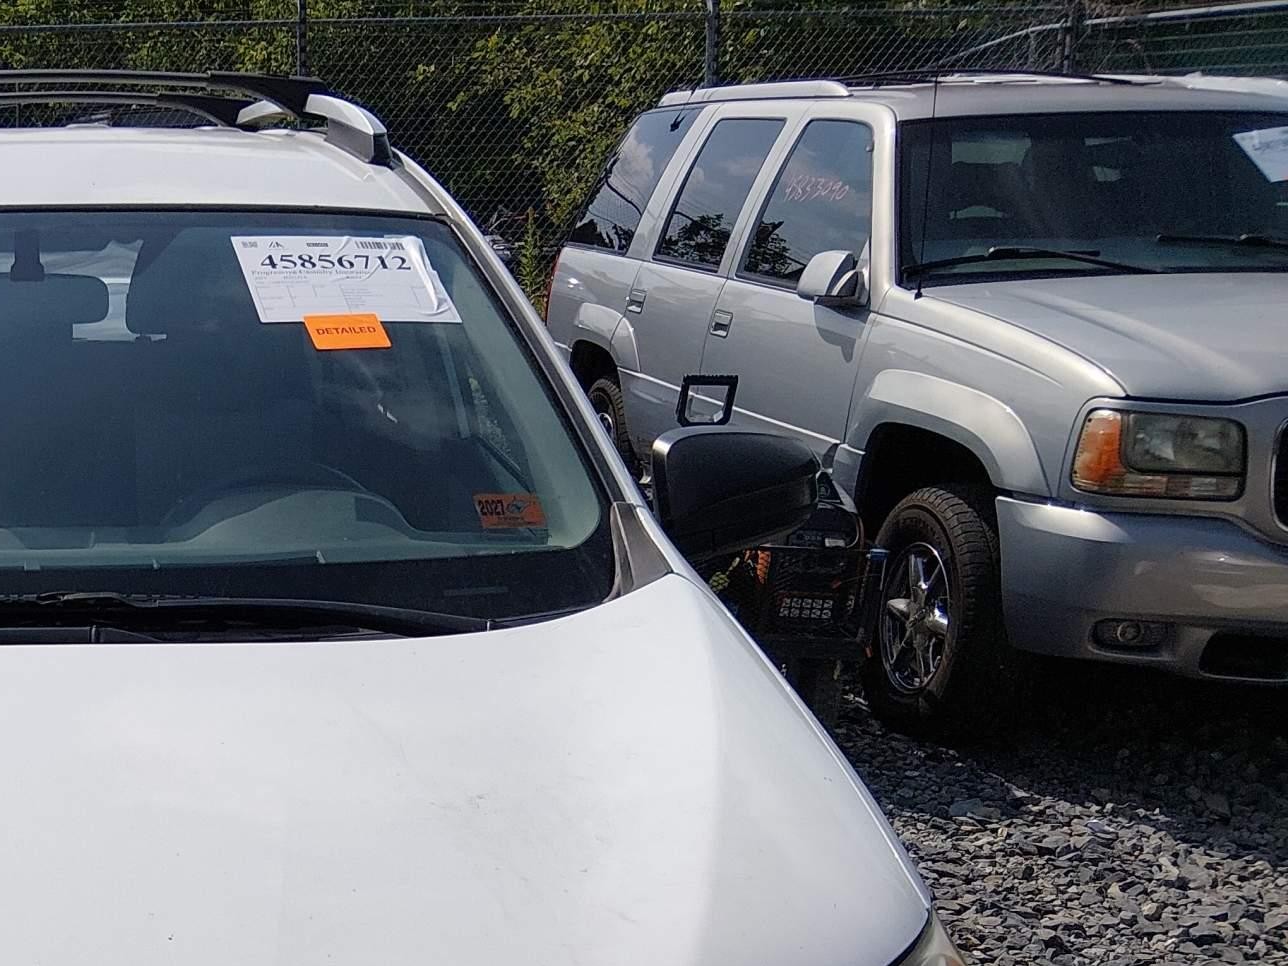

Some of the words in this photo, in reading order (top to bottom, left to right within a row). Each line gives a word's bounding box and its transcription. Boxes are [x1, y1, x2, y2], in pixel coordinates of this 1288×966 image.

[260, 254, 412, 271] 45856712
[315, 326, 377, 336] DETAILED
[478, 499, 506, 516] 2027
